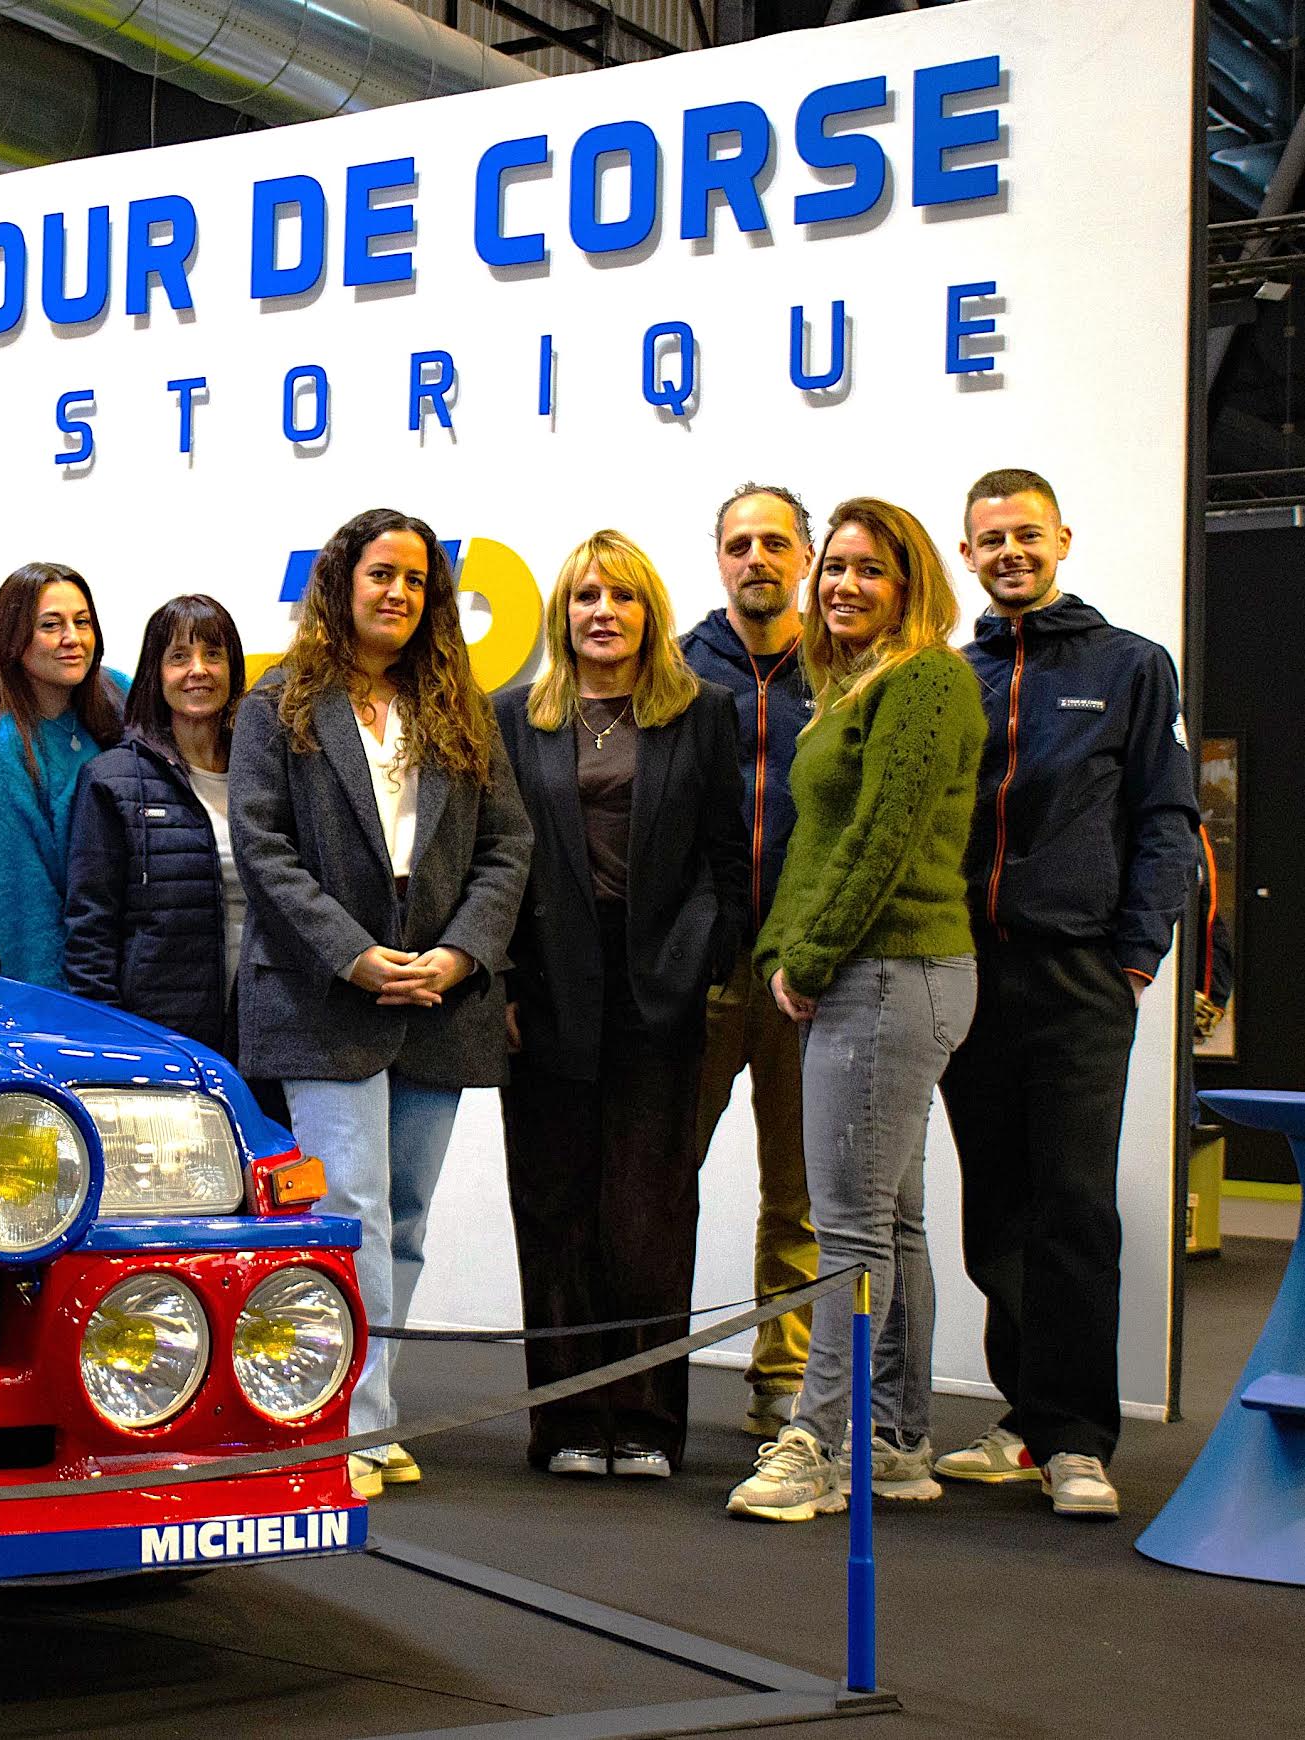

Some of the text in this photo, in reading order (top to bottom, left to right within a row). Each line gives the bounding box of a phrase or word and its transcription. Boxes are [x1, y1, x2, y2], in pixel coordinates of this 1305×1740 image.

[251, 158, 415, 298] DE
[475, 56, 1000, 266] CORSE
[142, 1511, 349, 1565] MICHELIN
